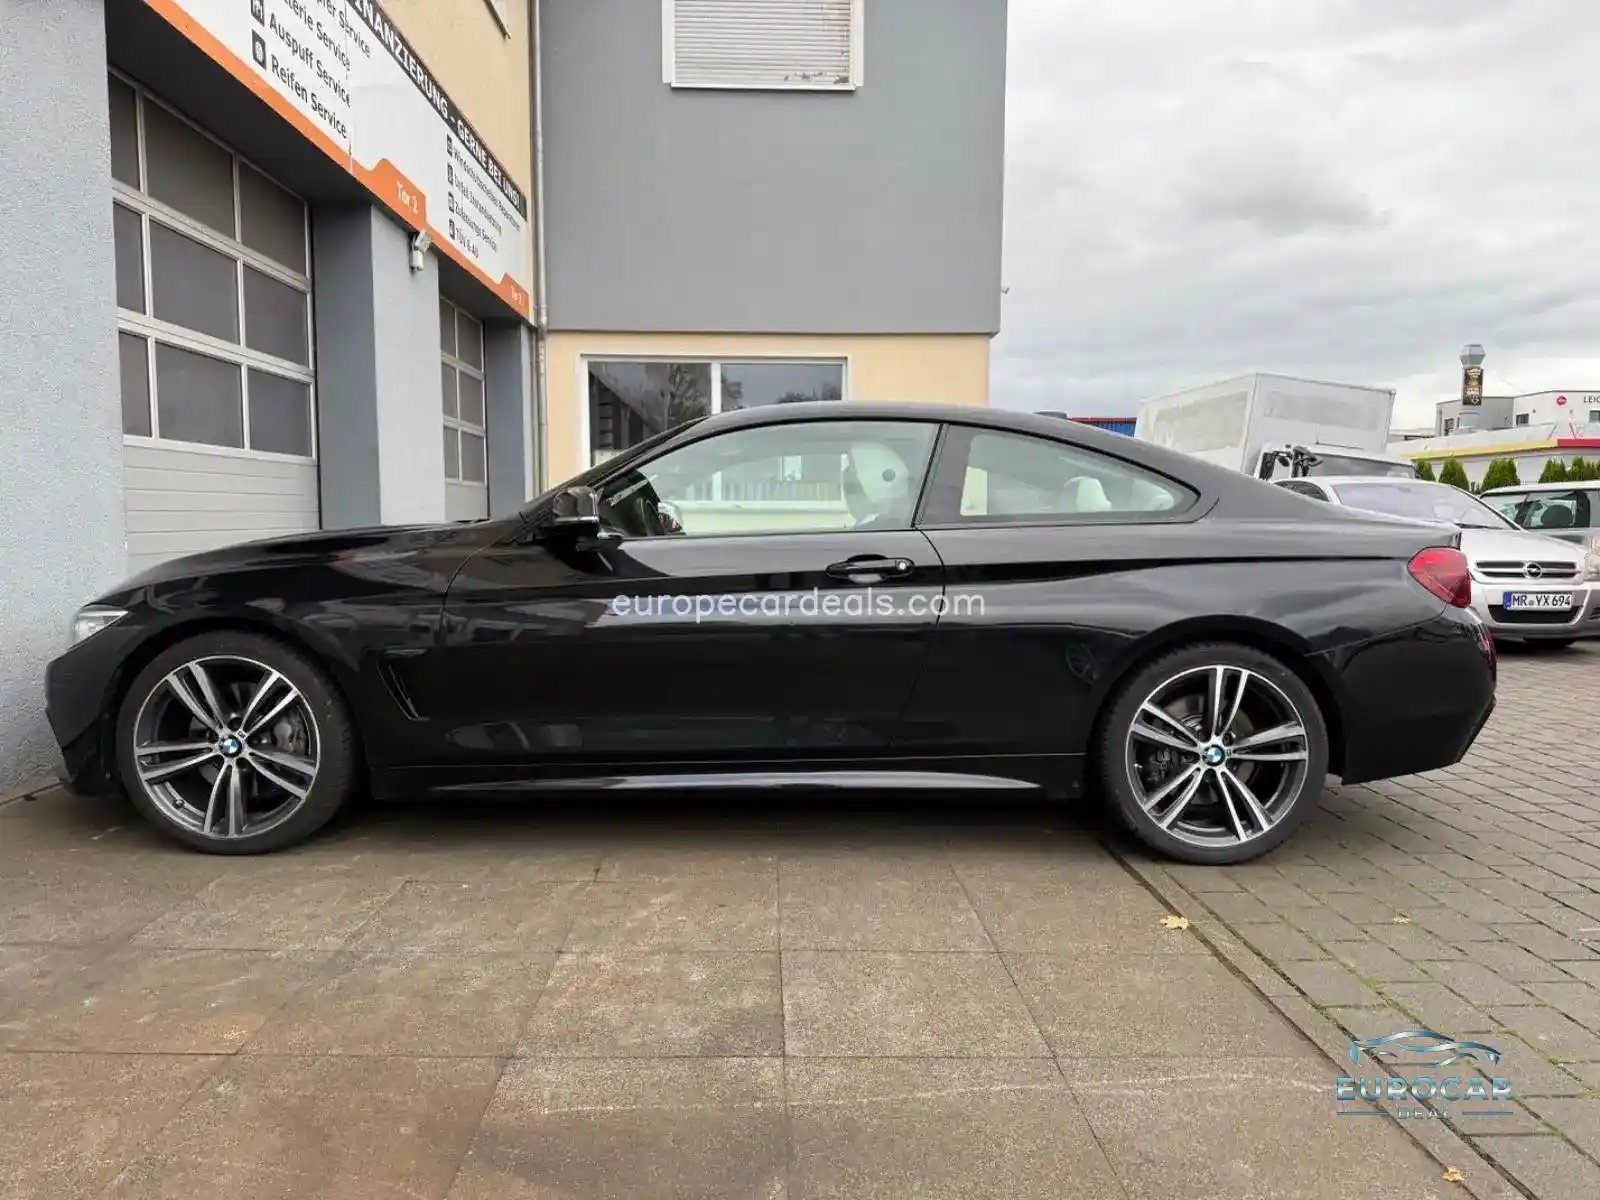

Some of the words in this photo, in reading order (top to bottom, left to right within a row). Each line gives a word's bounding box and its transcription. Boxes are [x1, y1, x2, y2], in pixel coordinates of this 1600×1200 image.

[269, 12, 314, 70] Auspuff
[316, 59, 351, 108] Service
[284, 0, 314, 31] terie
[316, 21, 351, 71] Service
[338, 10, 371, 59] Service
[270, 54, 308, 103] Reifen
[310, 92, 348, 139] Service
[1512, 594, 1528, 607] MR
[1535, 594, 1550, 607] YX
[1551, 594, 1571, 607] 694
